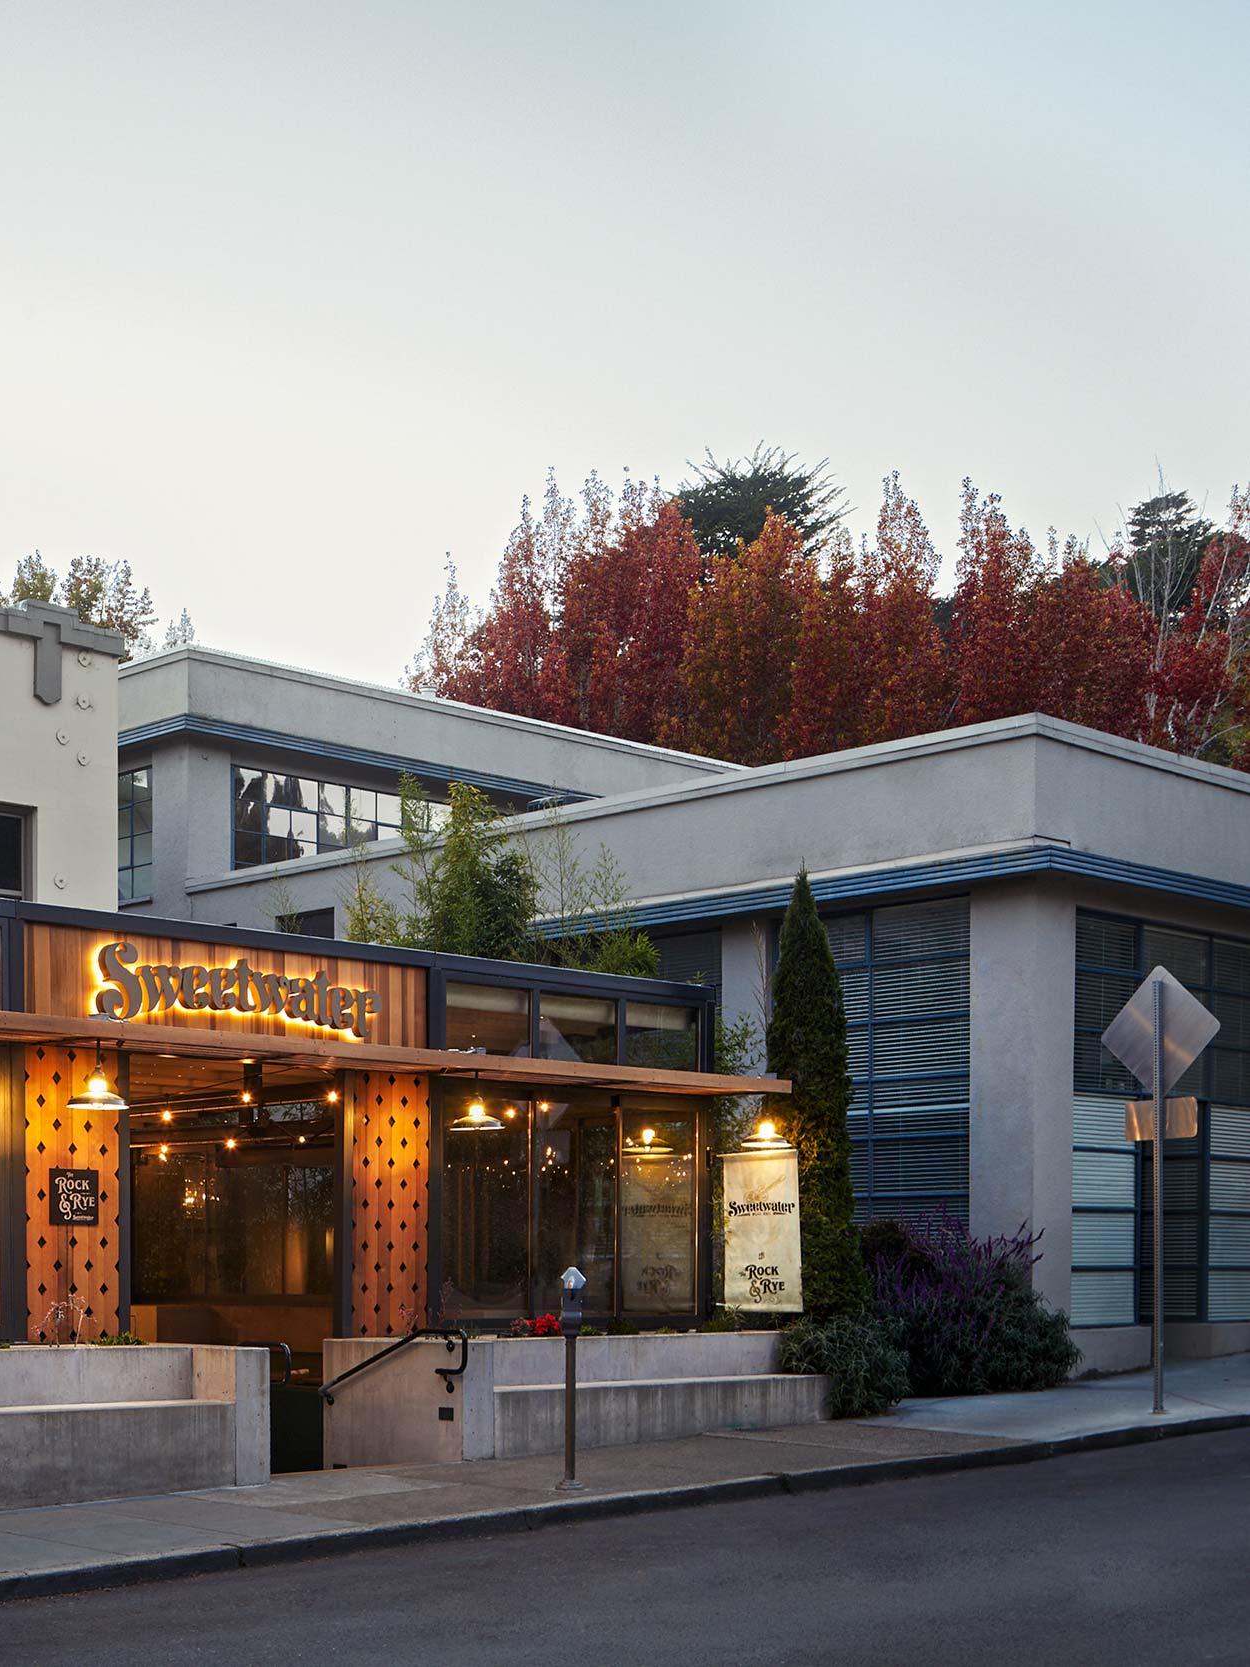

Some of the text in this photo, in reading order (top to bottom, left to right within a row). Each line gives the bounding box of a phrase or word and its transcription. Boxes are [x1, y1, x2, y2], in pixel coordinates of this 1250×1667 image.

[96, 941, 382, 1038] Sweetwater
[55, 1176, 90, 1194] ROCK
[59, 1193, 95, 1220] & RYE
[728, 1201, 795, 1217] Sweetwater
[745, 1264, 779, 1280] ROCK
[749, 1278, 785, 1304] & RYE
